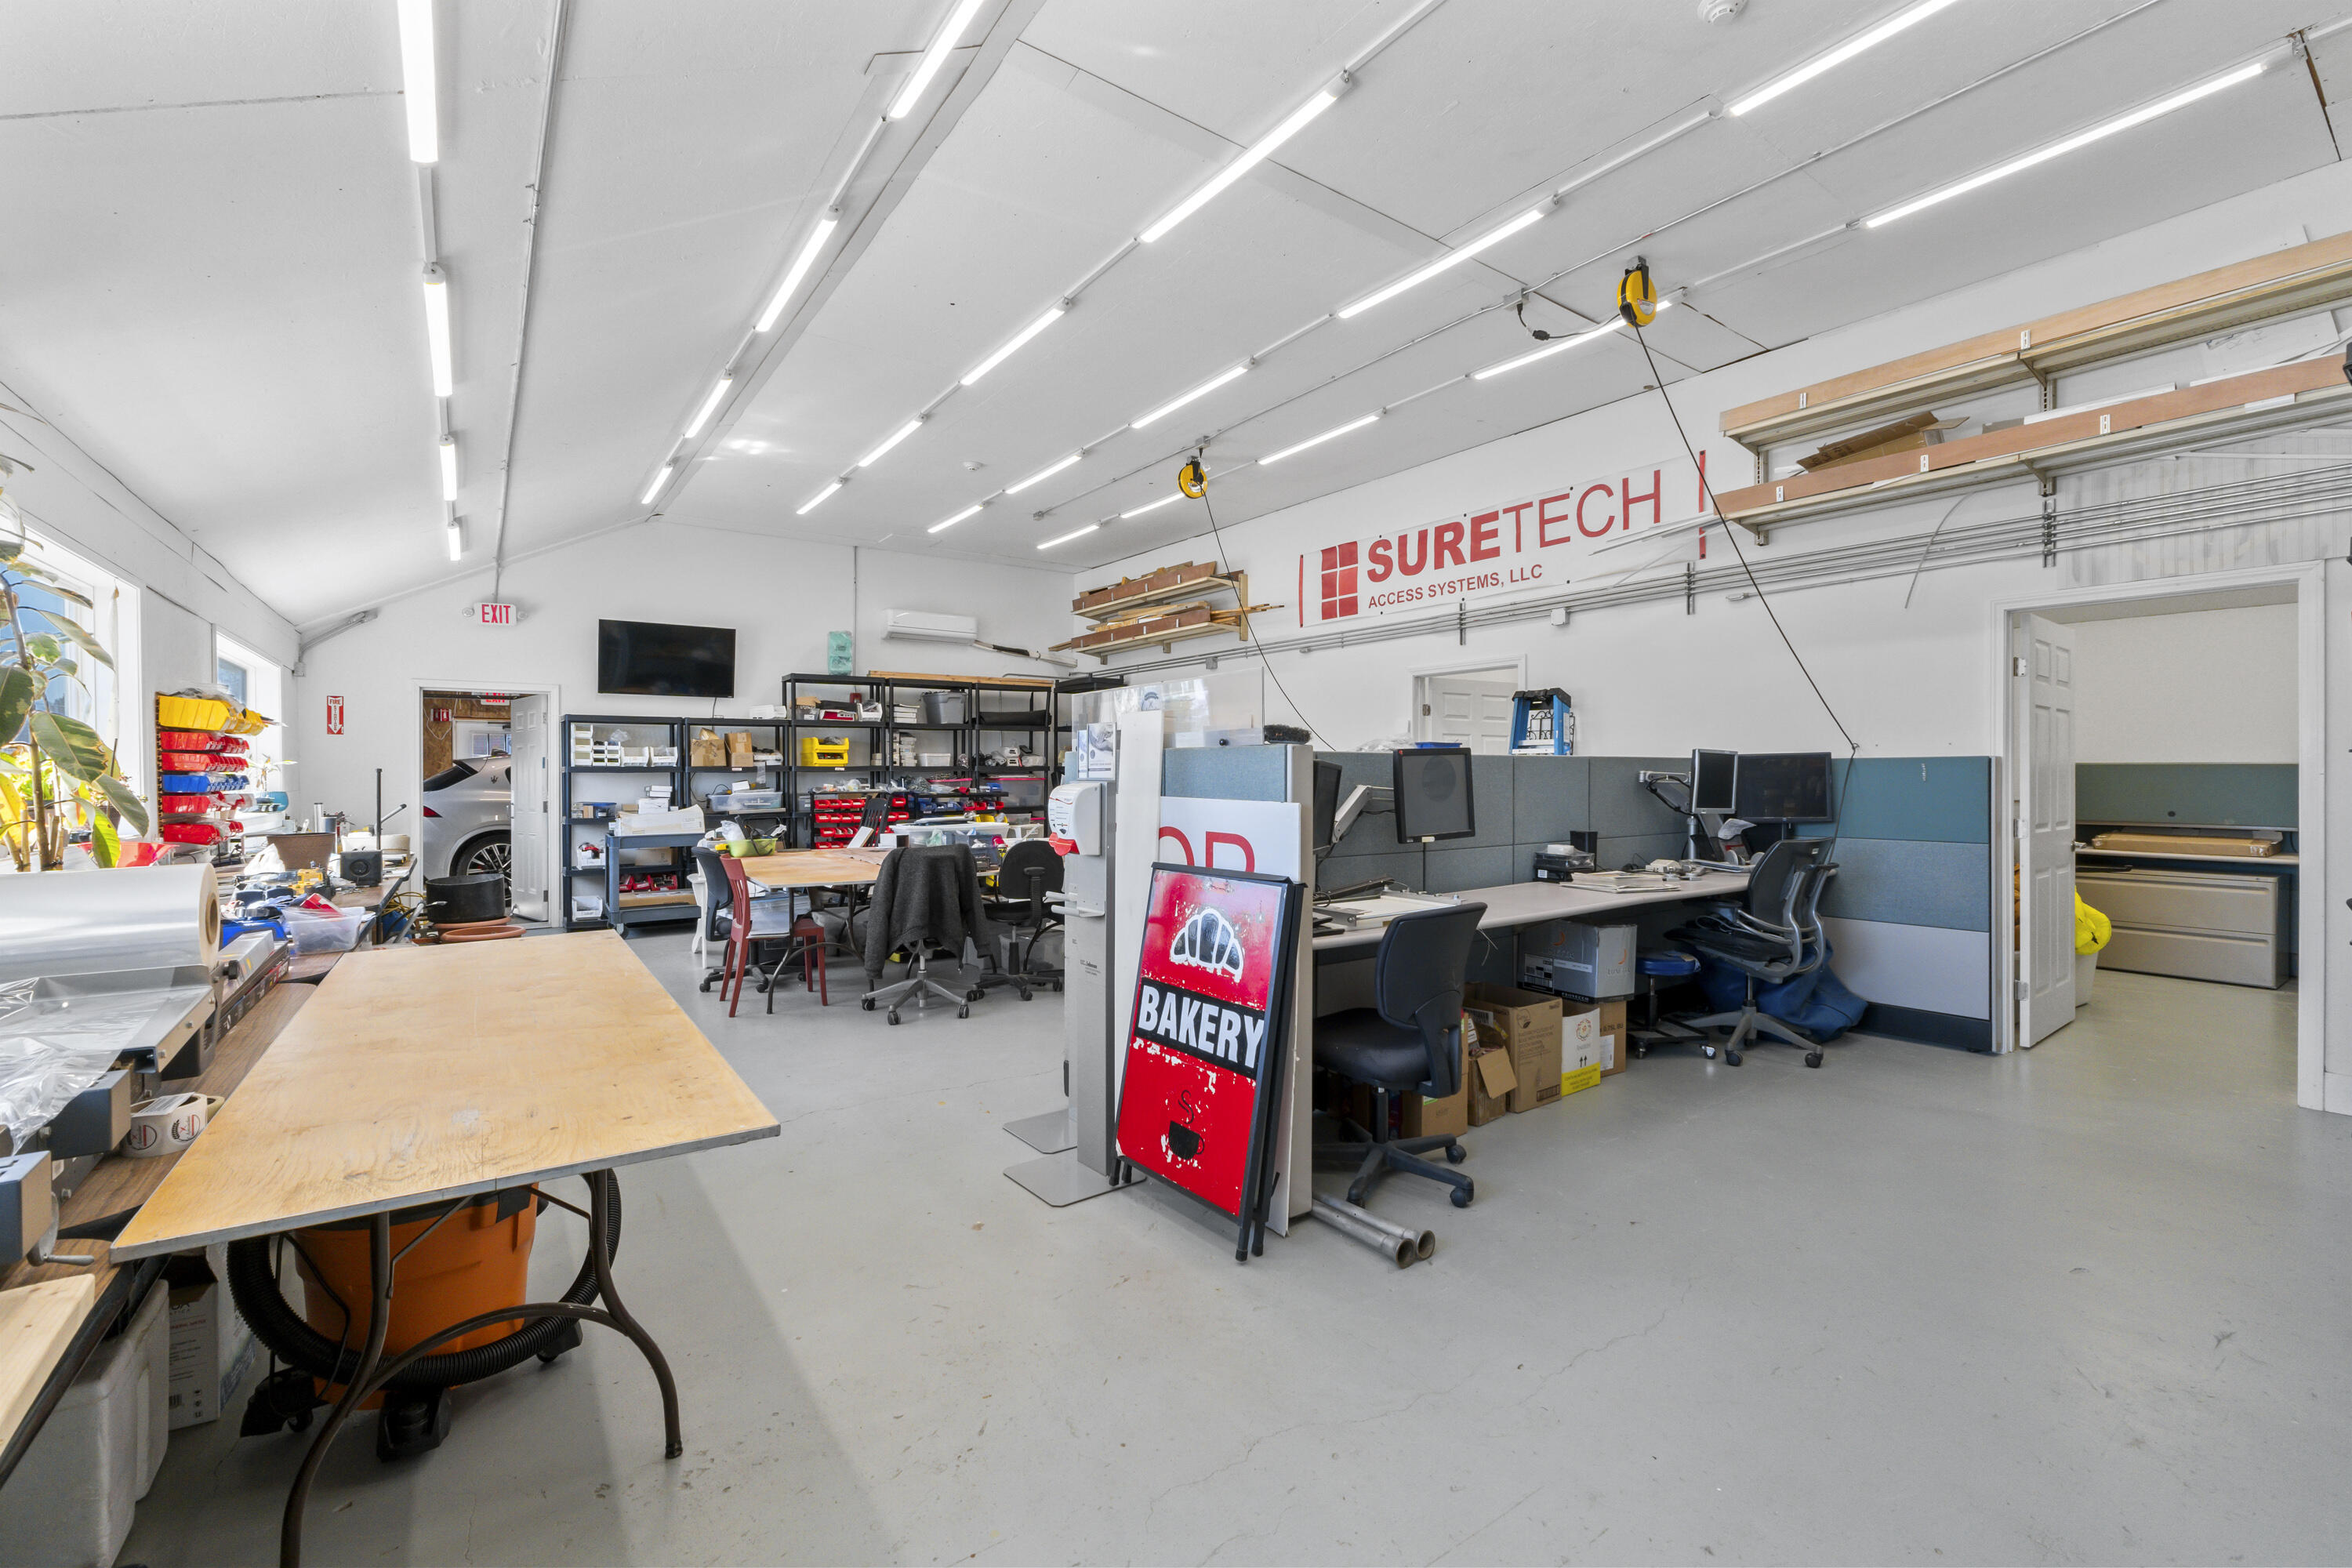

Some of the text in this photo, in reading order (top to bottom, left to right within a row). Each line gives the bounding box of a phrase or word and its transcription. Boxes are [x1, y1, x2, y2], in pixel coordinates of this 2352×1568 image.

[1367, 470, 1661, 583] SURETECH
[481, 604, 511, 624] EXIT
[1368, 564, 1543, 608] ACCESS SYSTEMS, LLC
[1138, 985, 1265, 1069] BAKERY
